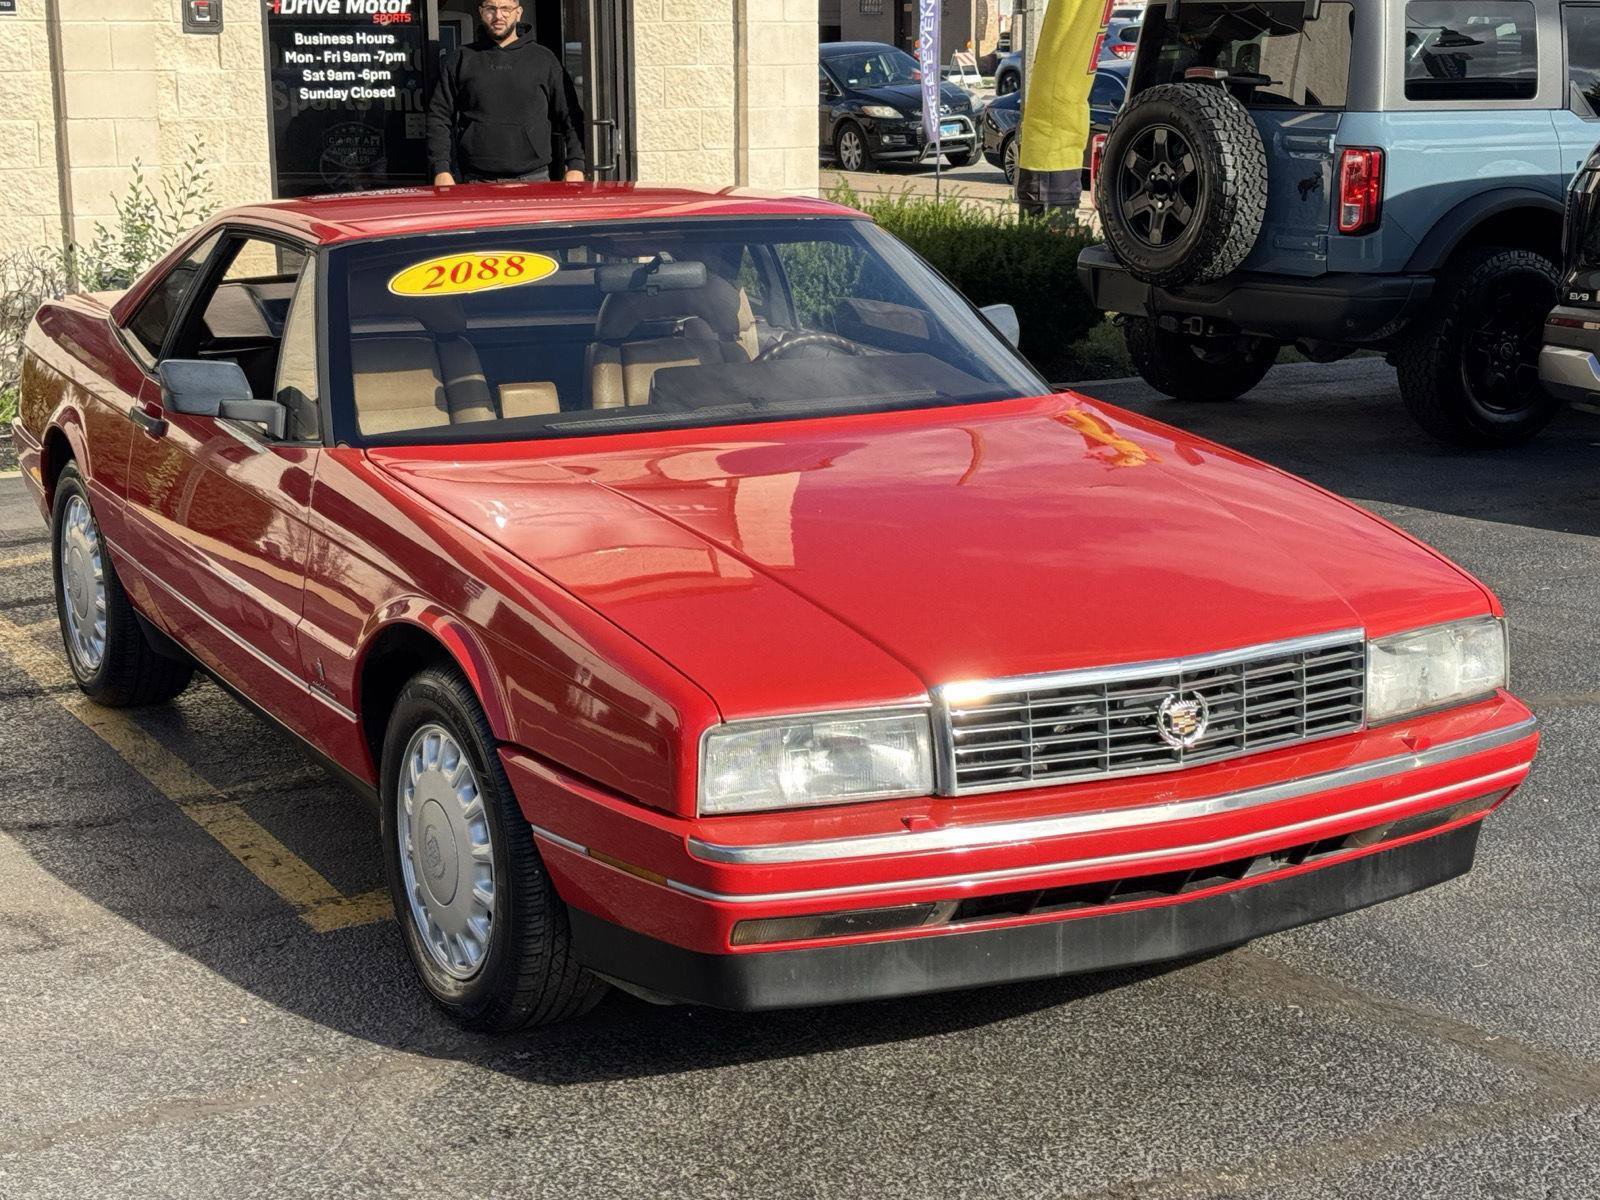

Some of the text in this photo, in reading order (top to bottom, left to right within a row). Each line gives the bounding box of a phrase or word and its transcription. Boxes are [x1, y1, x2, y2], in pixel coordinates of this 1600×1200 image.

[345, 0, 411, 14] Motor
[372, 13, 412, 24] SPORTS
[294, 32, 395, 46] Business Hours
[285, 51, 314, 64] Mon
[323, 51, 341, 63] Fri
[343, 51, 372, 63] 9am
[373, 51, 407, 65] -7pm
[302, 69, 392, 83] Sat 9am -6pm
[299, 86, 396, 102] Sunday Closed
[422, 254, 527, 291] 2088
